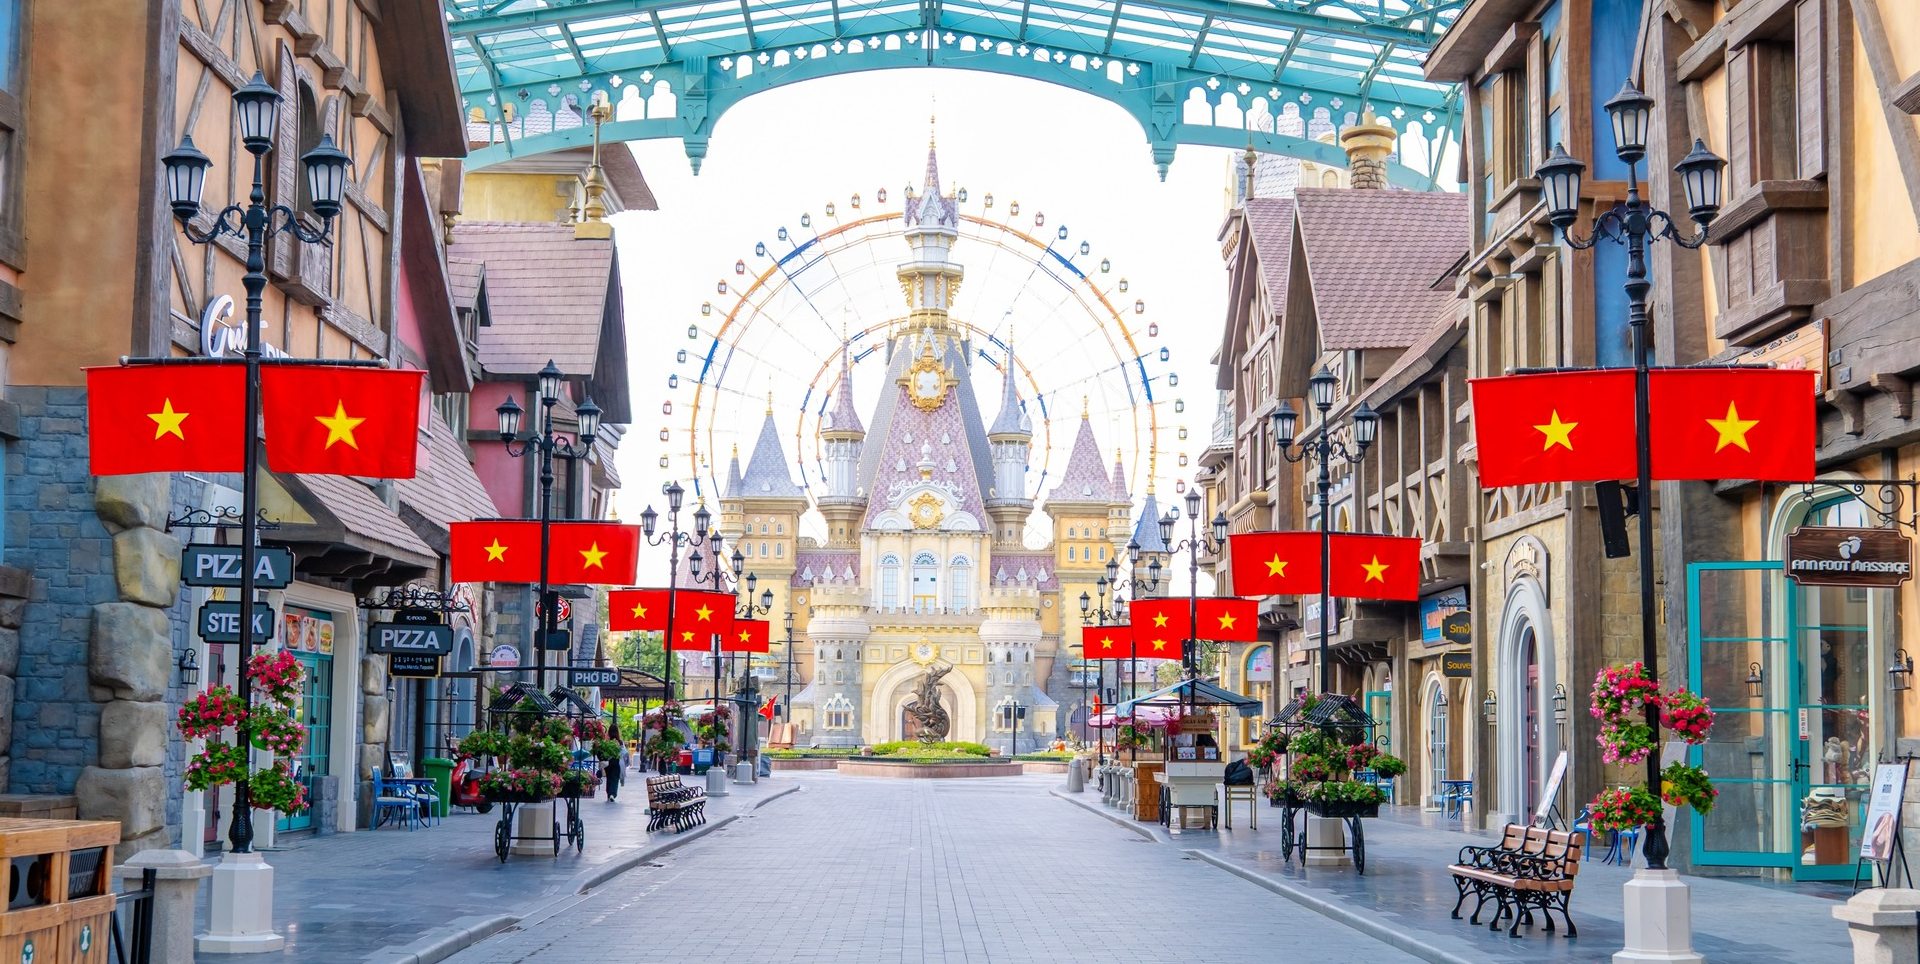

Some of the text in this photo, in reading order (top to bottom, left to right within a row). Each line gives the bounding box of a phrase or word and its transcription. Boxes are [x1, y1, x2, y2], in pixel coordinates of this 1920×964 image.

[1819, 560, 1850, 571] FOOT
[1851, 560, 1910, 574] MASSAGE
[207, 612, 264, 634] STEK
[381, 629, 440, 649] PIZZA
[1447, 661, 1472, 669] Souve
